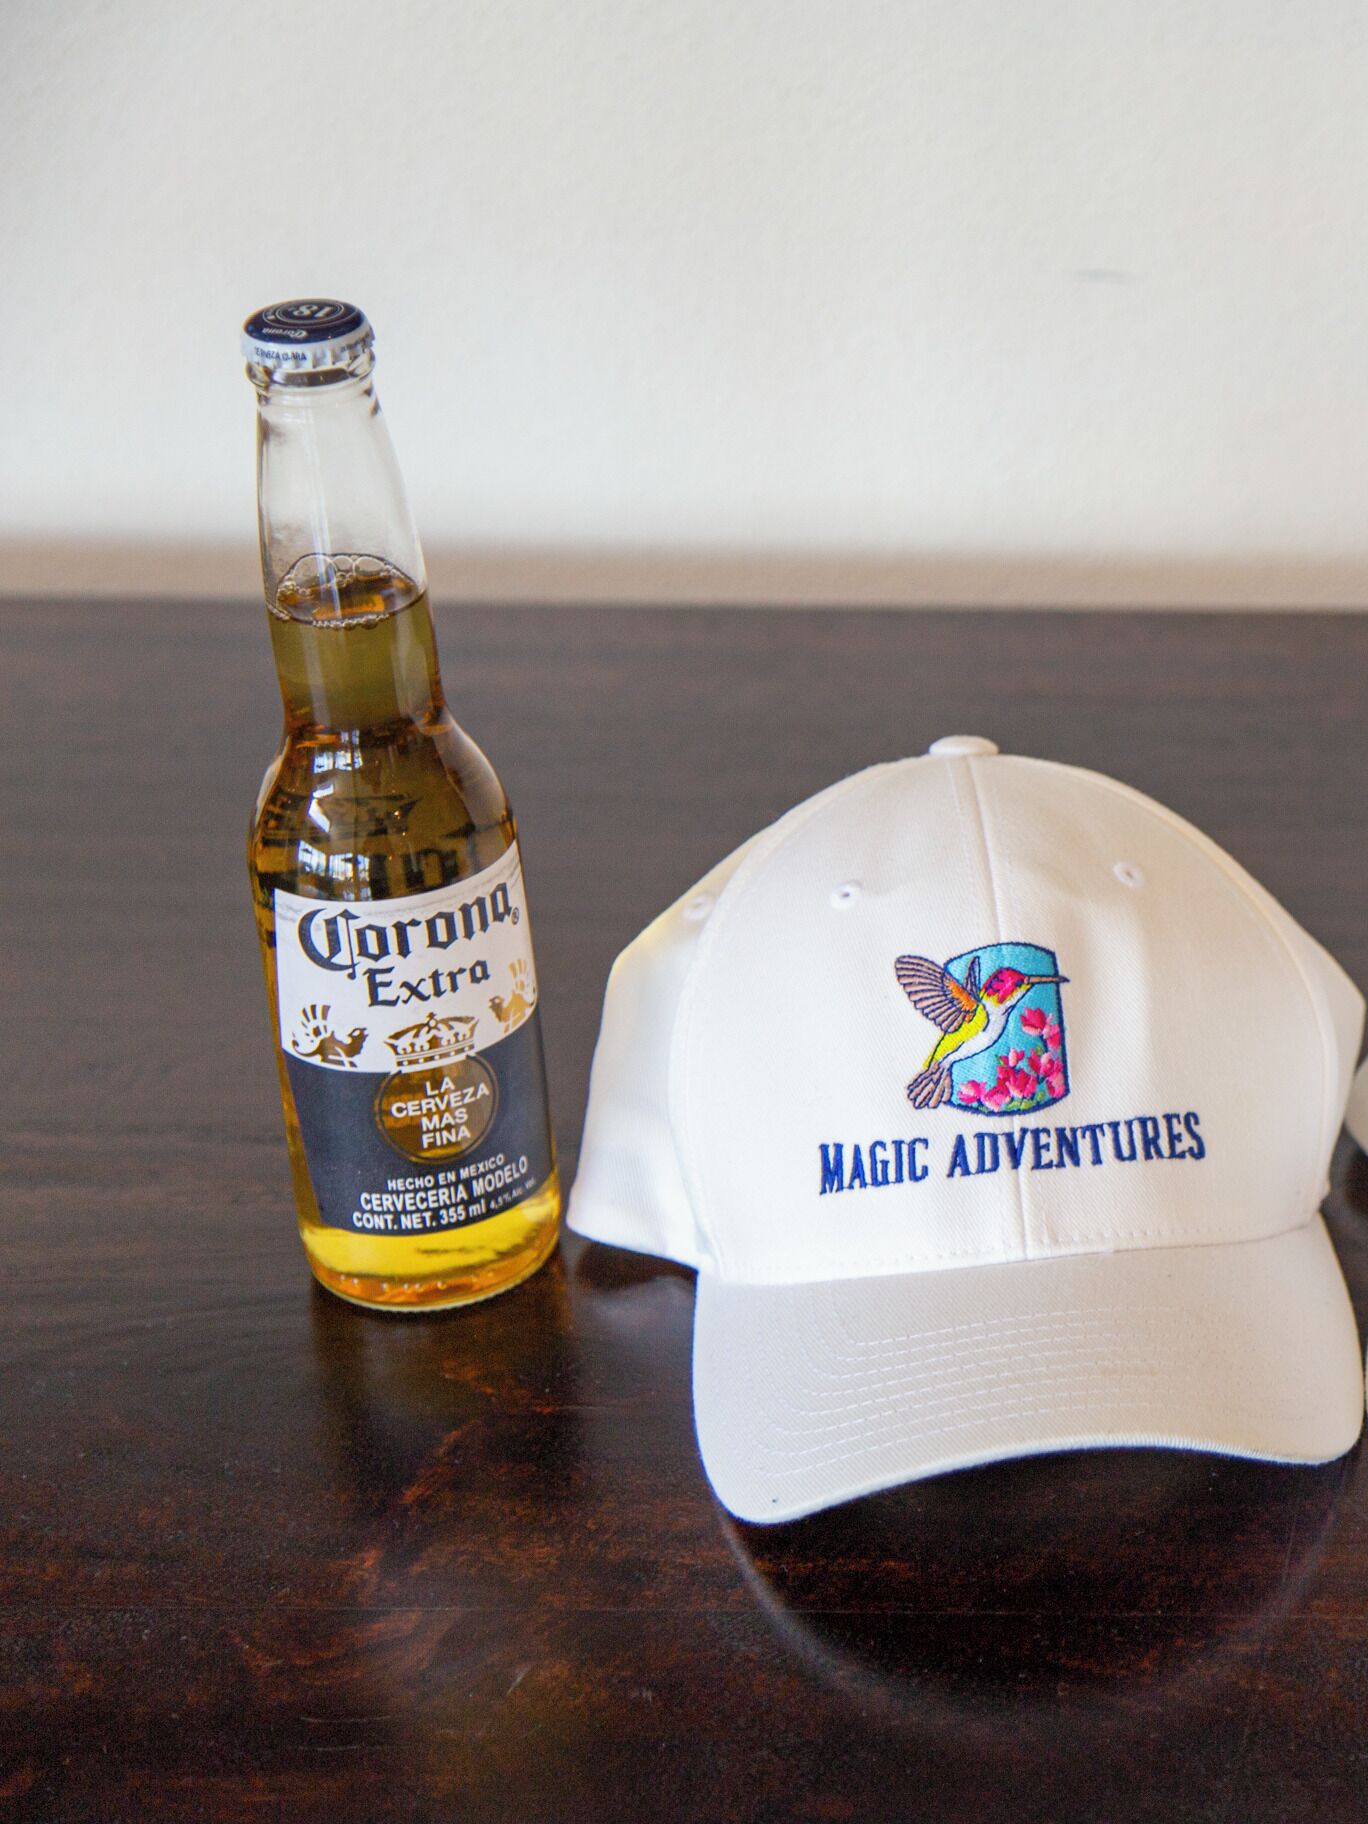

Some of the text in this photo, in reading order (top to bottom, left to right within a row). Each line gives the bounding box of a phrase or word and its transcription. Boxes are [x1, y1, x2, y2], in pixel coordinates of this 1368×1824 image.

[298, 882, 512, 980] Corona
[363, 960, 490, 1007] Extra
[391, 1082, 490, 1118] CERVEZA
[425, 1076, 455, 1097] LA
[420, 1108, 468, 1132] MAS
[422, 1126, 471, 1149] FINA
[387, 1153, 505, 1191] HECHO EN MEXICO
[818, 1111, 1206, 1196] MAGIC ADVENTURES
[360, 1155, 528, 1212] CERVECERIA MODELO
[353, 1211, 398, 1230] CONT.
[401, 1213, 436, 1230] NET.
[439, 1207, 467, 1225] 355
[468, 1198, 486, 1217] ml
